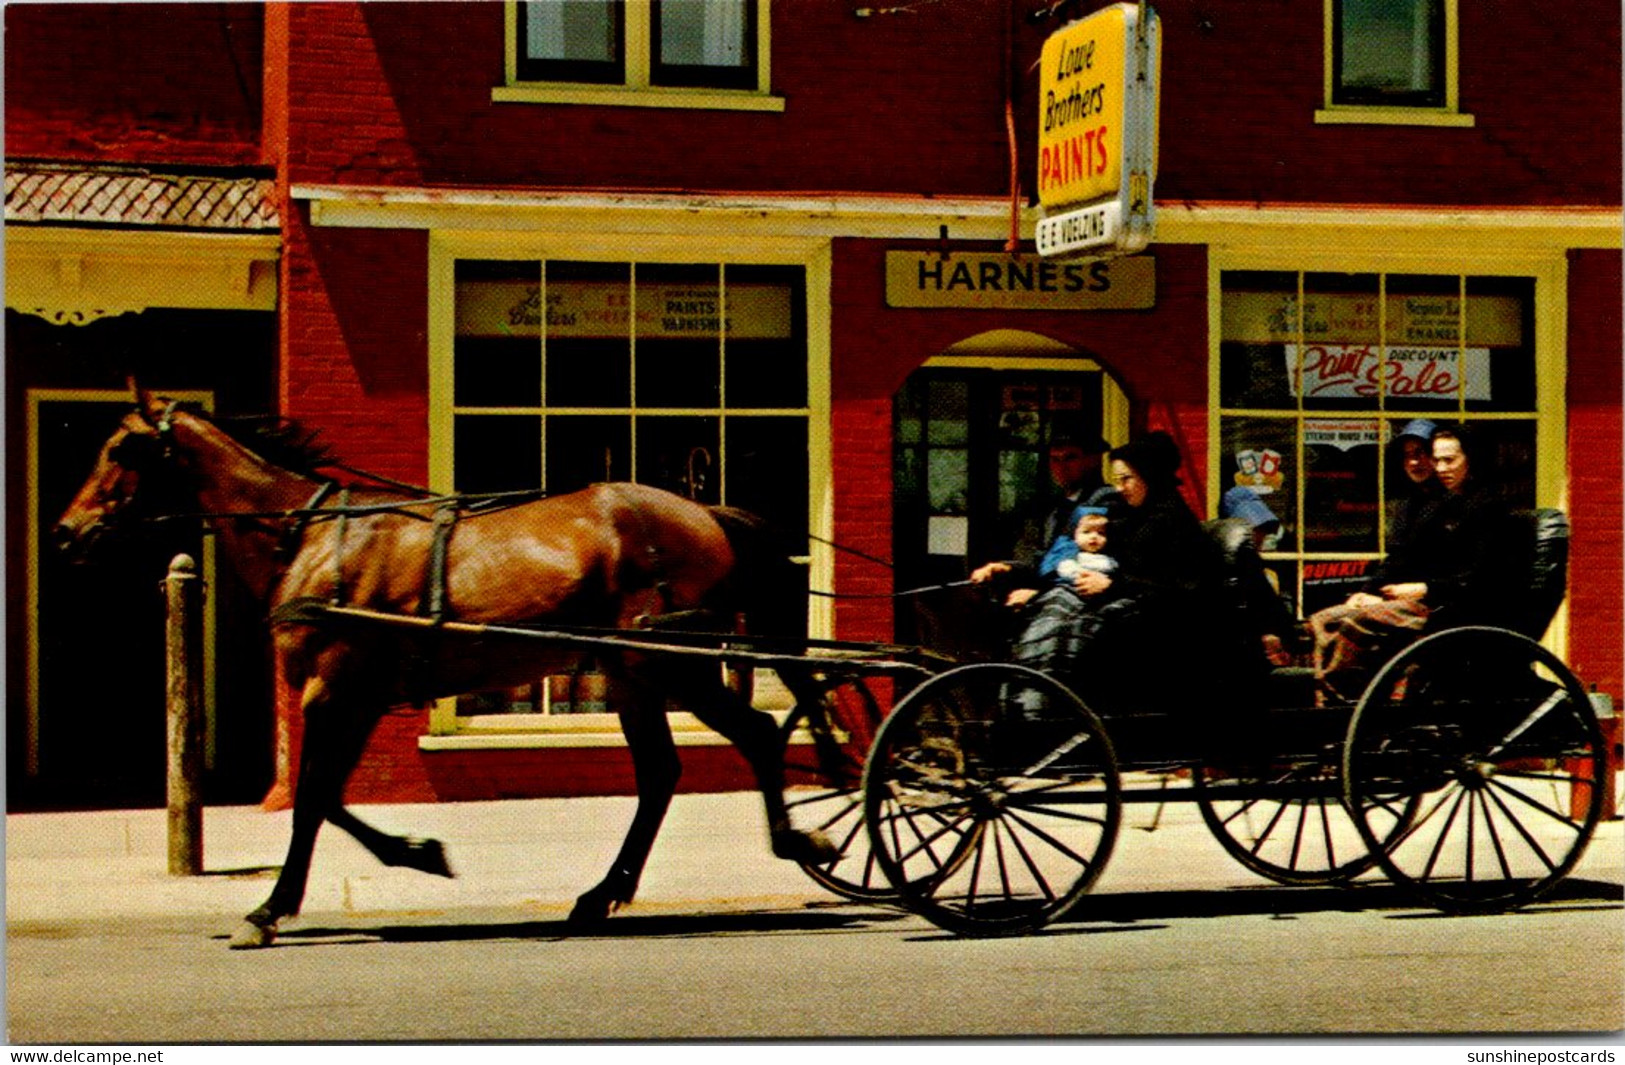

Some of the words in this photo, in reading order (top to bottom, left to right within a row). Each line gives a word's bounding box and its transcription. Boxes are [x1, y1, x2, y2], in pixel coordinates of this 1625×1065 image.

[1057, 40, 1095, 81] Lowe
[1045, 82, 1105, 131] Brothers
[1041, 126, 1107, 190] PAINTS
[918, 260, 1112, 292] HARNESS
[666, 301, 715, 314] PAINTS
[1294, 344, 1376, 389] Paint
[1354, 361, 1461, 396] Sale
[1389, 350, 1459, 361] DISCOUNT
